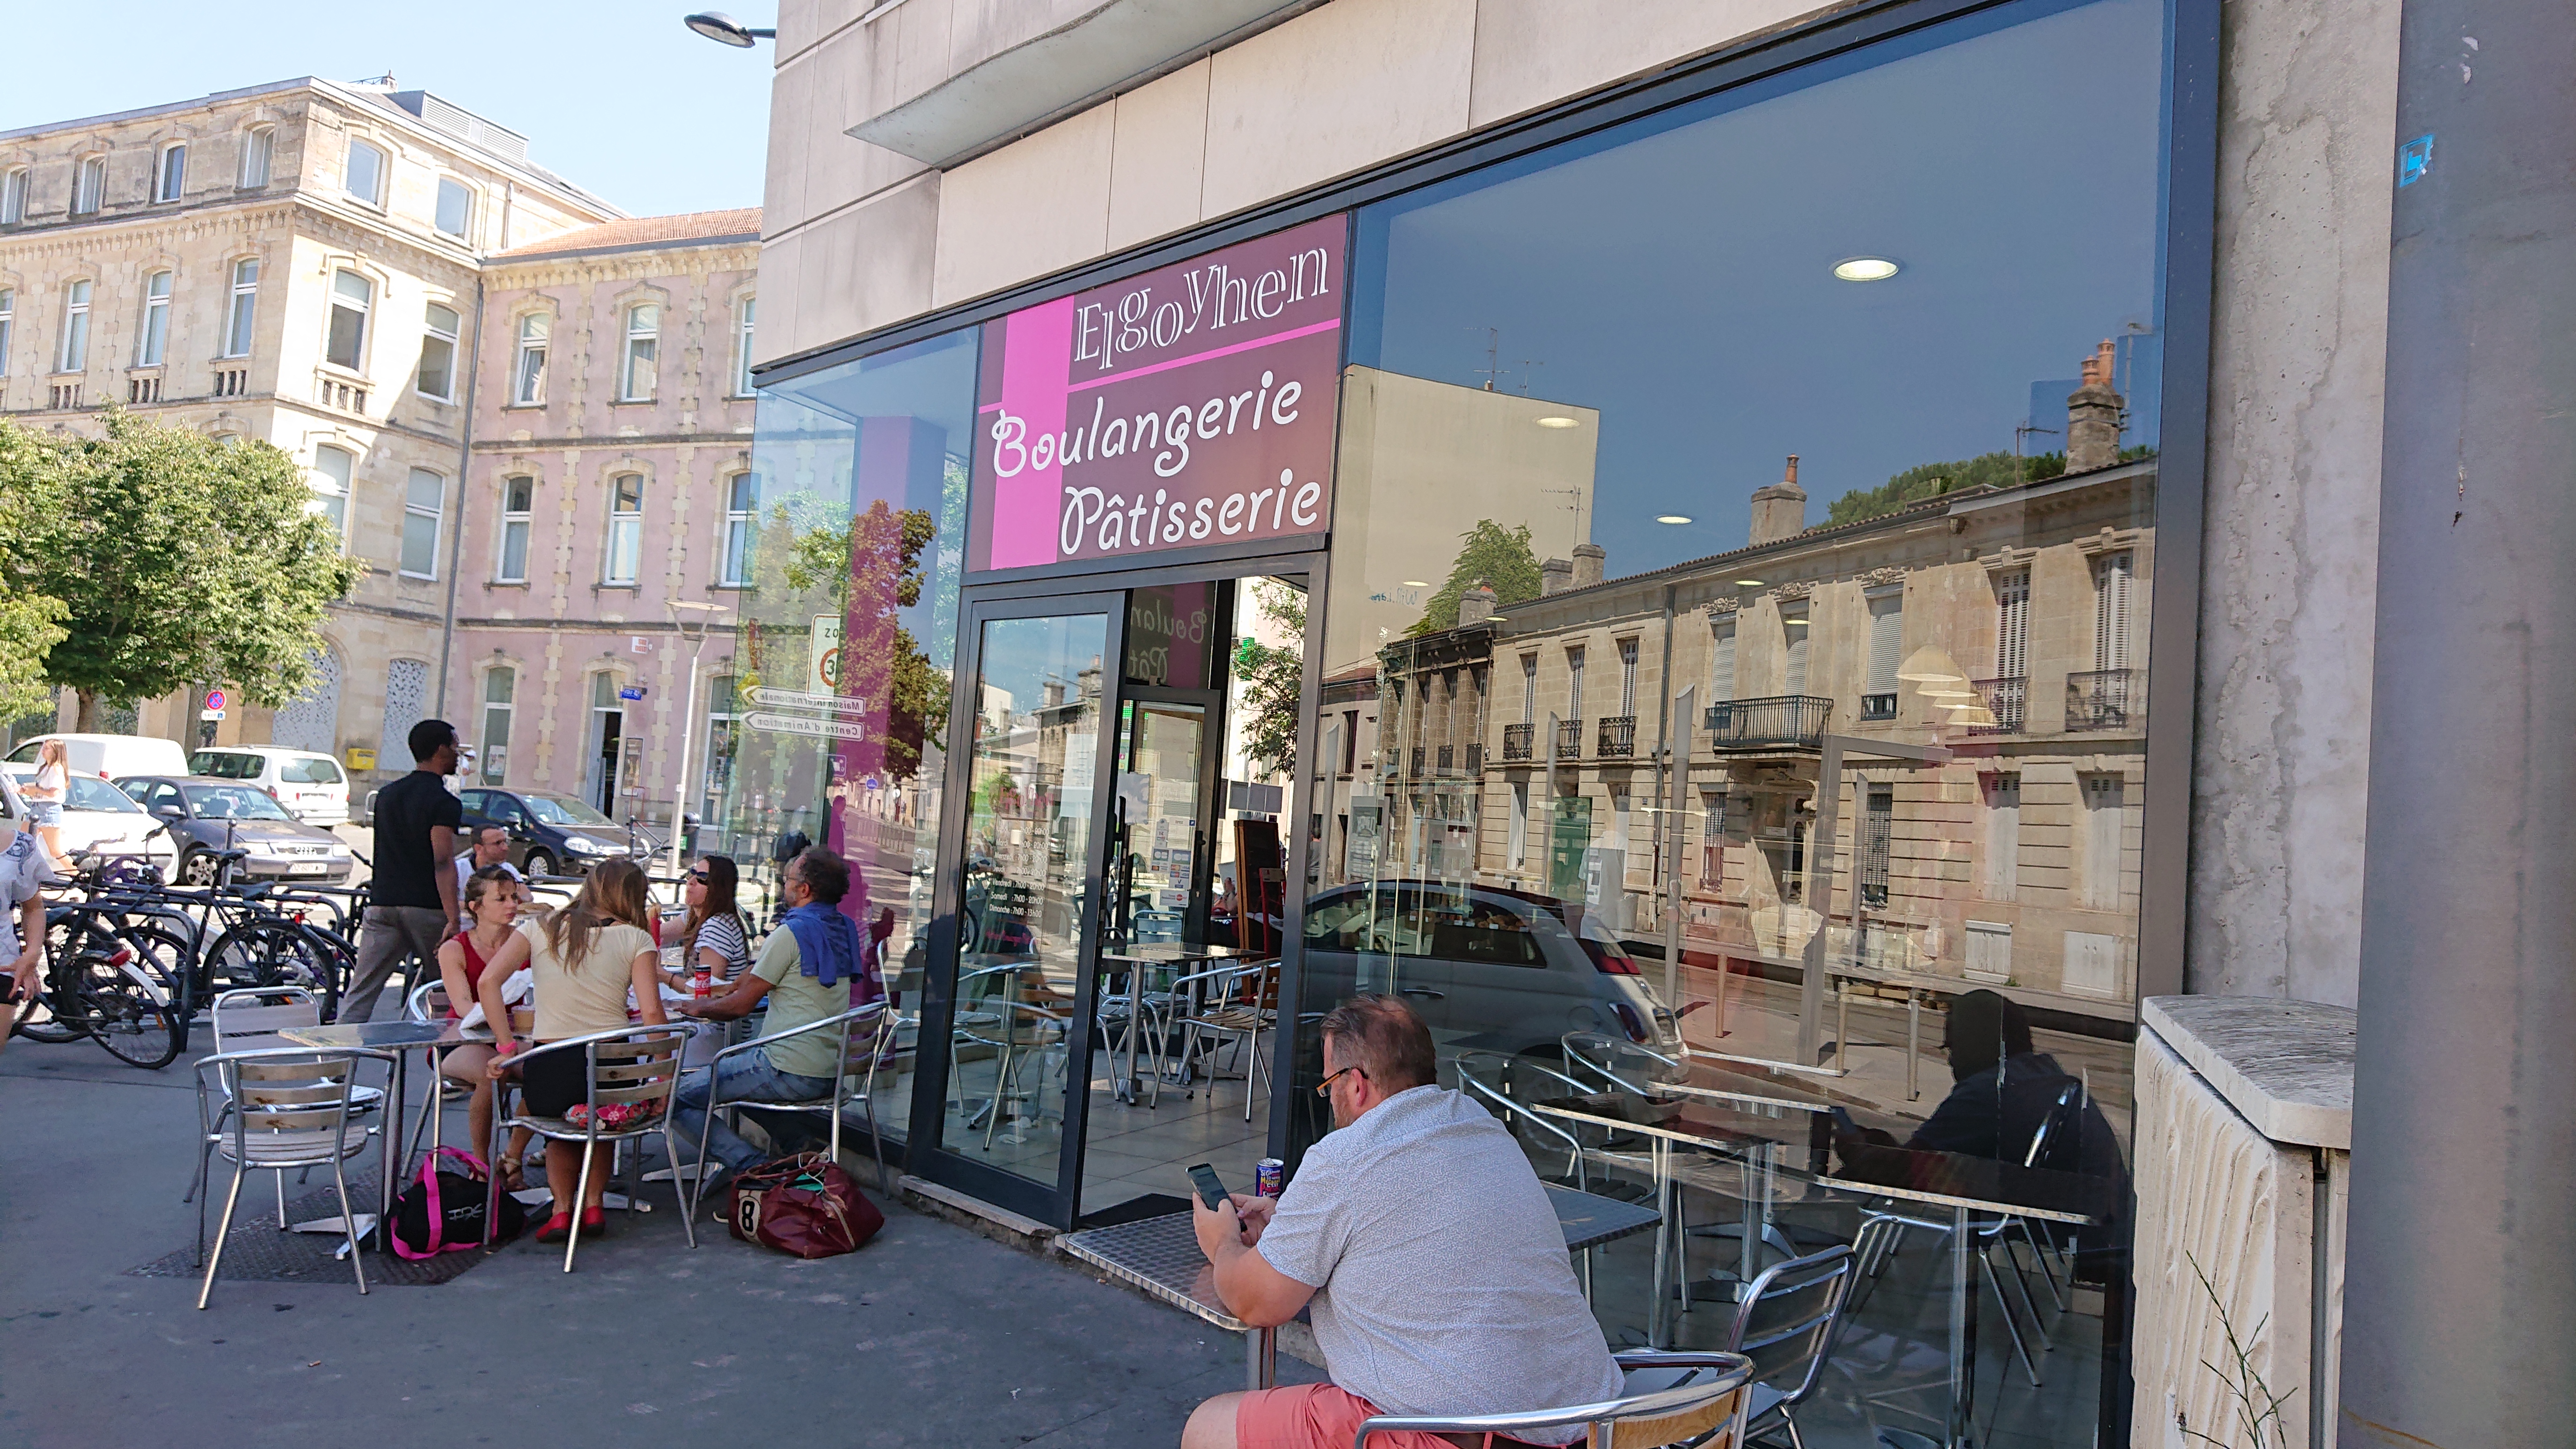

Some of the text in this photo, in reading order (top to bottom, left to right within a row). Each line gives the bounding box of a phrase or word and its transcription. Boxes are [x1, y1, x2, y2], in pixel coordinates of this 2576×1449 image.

[991, 370, 1303, 478] Boulangerie
[1061, 468, 1322, 555] Pâtisserie
[995, 851, 1013, 860] Mercredi
[992, 878, 1012, 888] Vendredi
[991, 892, 1007, 900] Samedi
[1028, 896, 1044, 905] 20h00
[989, 904, 1010, 914] Dimanche
[1027, 908, 1042, 918] 13h00
[742, 1200, 754, 1232] 8
